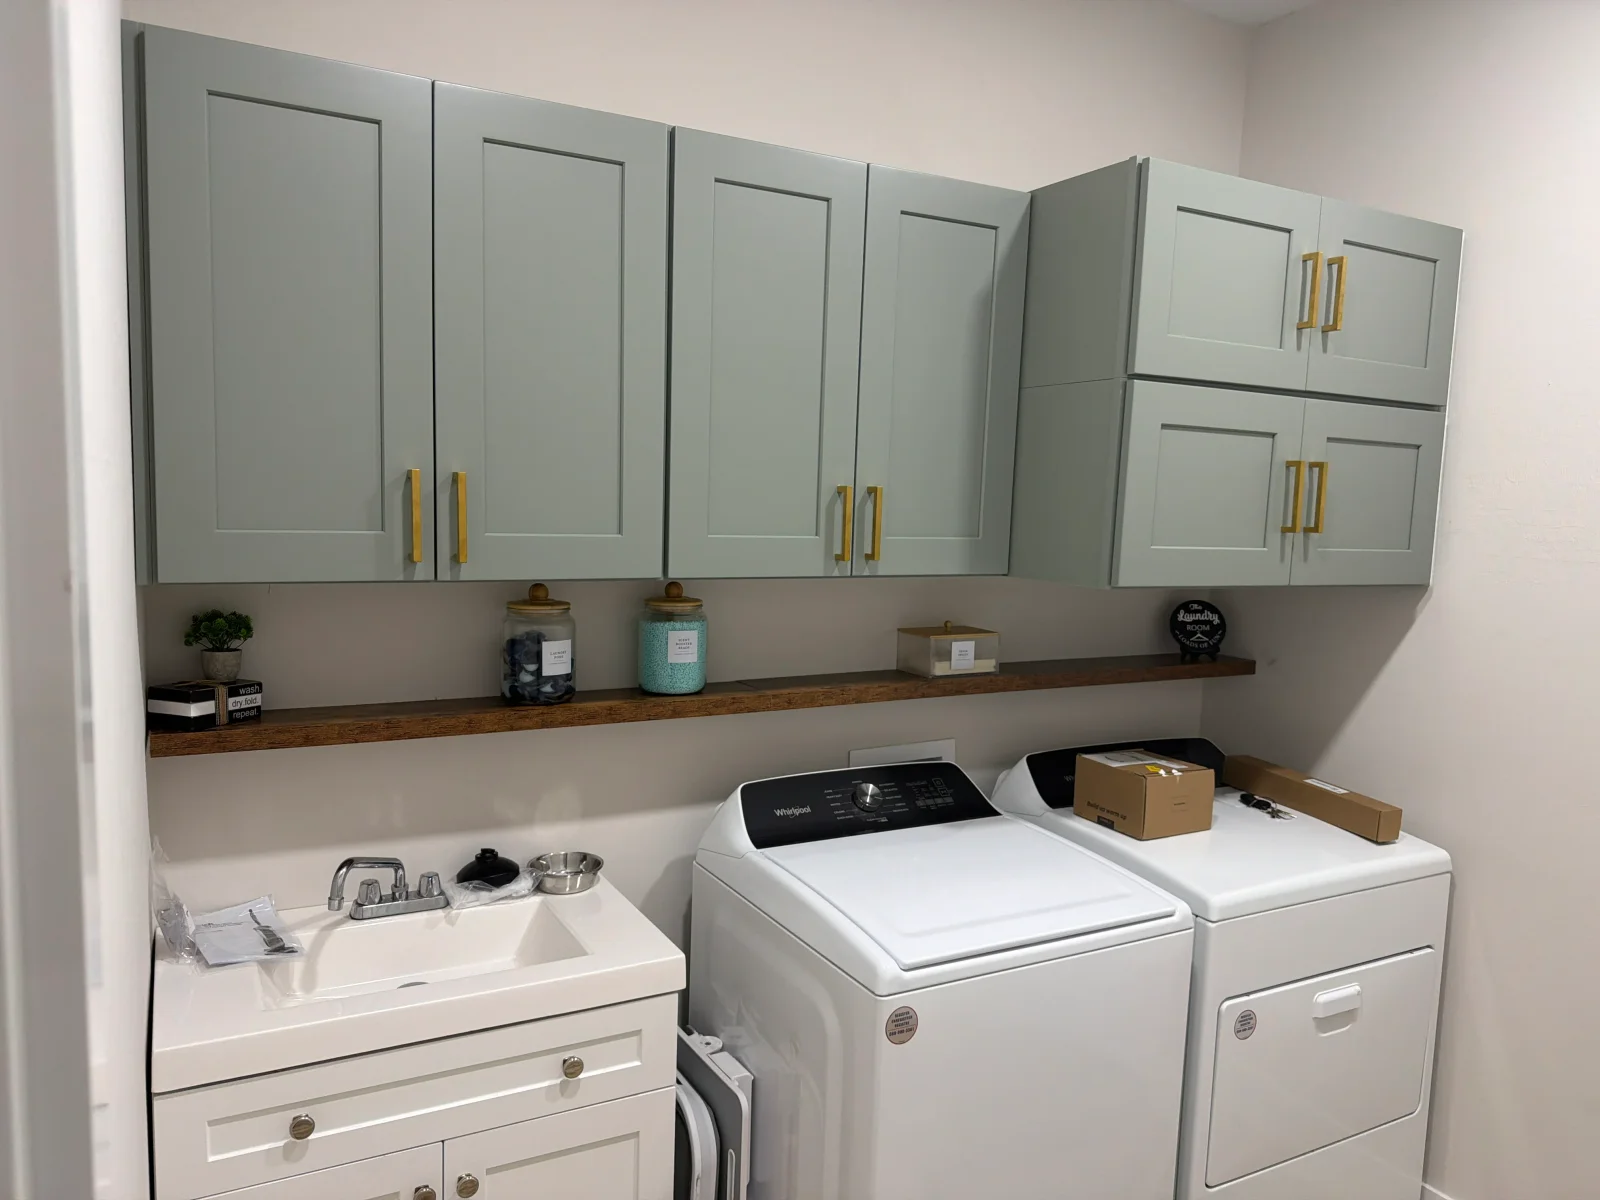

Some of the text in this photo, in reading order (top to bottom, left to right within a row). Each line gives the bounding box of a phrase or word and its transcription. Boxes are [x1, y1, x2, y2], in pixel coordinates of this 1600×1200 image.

[1177, 609, 1220, 625] Laundry
[239, 684, 262, 695] wash.
[232, 708, 259, 719] repeat.
[773, 804, 812, 818] Whirlpool
